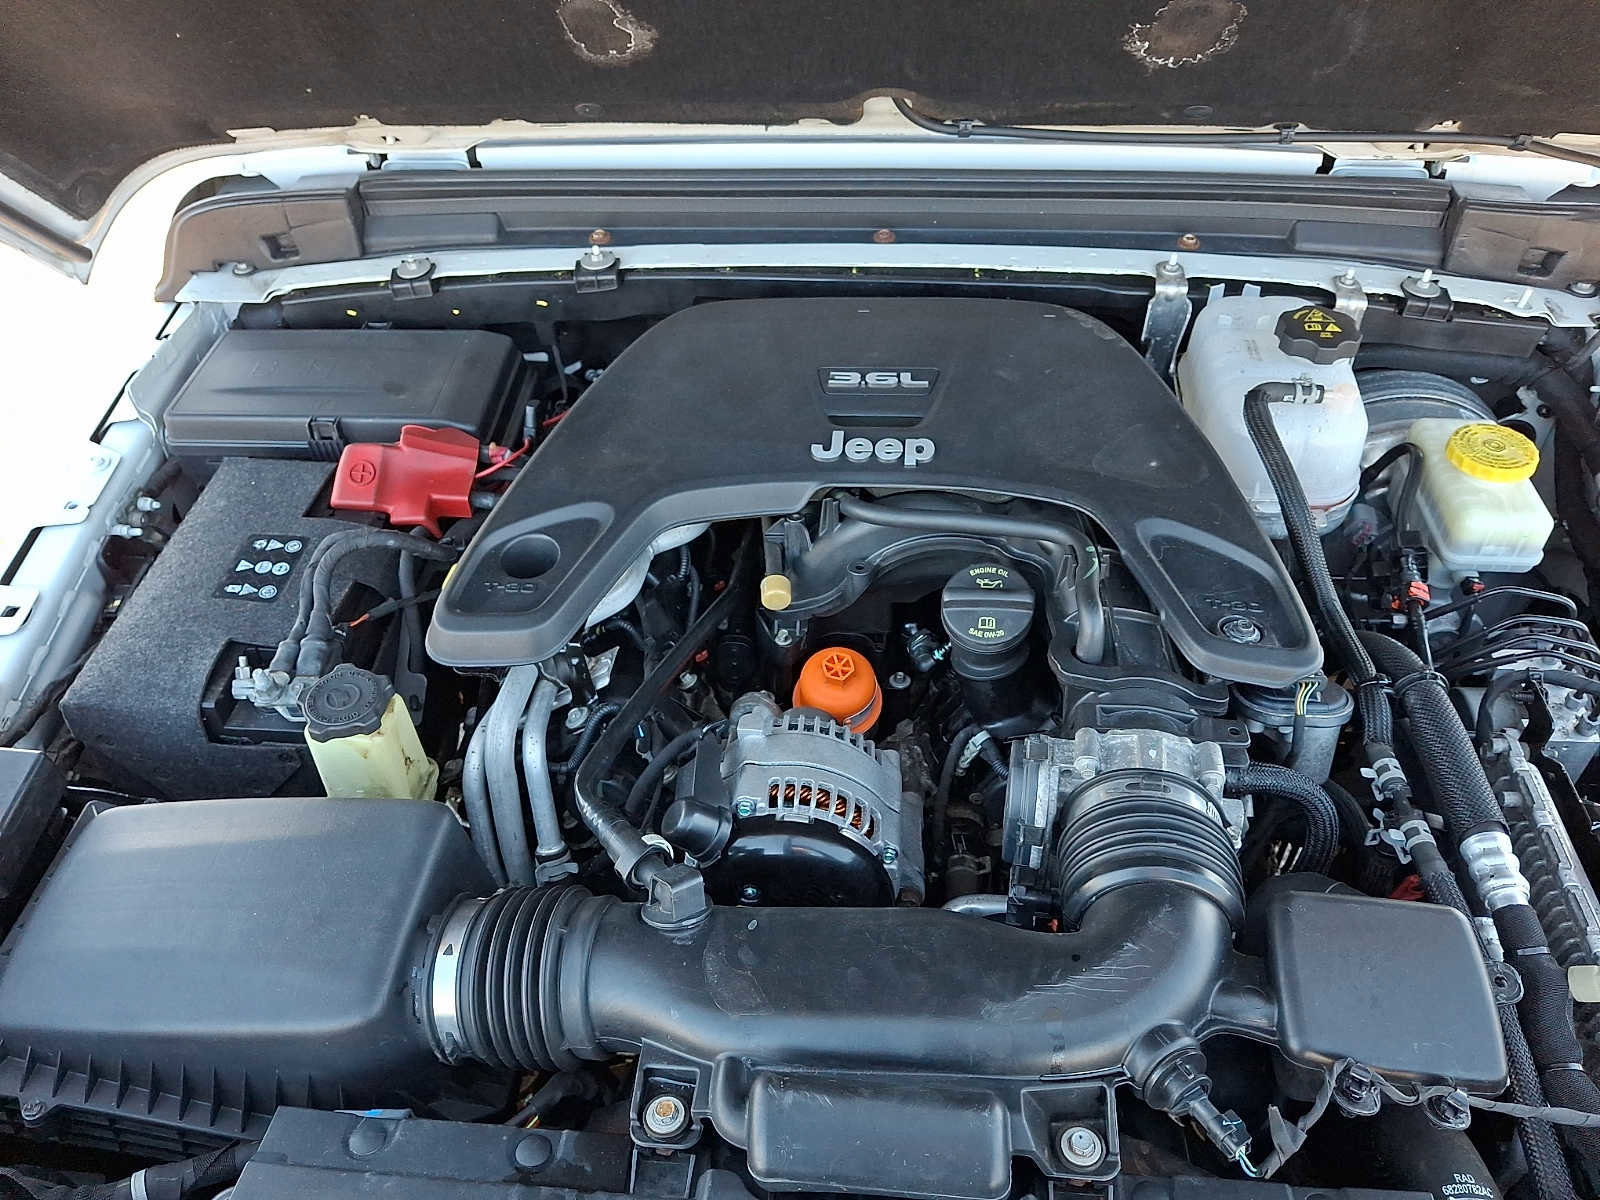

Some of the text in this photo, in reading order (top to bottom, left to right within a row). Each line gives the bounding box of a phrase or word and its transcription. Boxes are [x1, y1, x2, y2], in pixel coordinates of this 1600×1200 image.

[827, 371, 929, 388] 3.6L
[810, 430, 936, 467] Jeep
[969, 566, 1009, 578] ENGINE OIL
[968, 627, 983, 638] SAE
[1453, 1173, 1476, 1184] RAD
